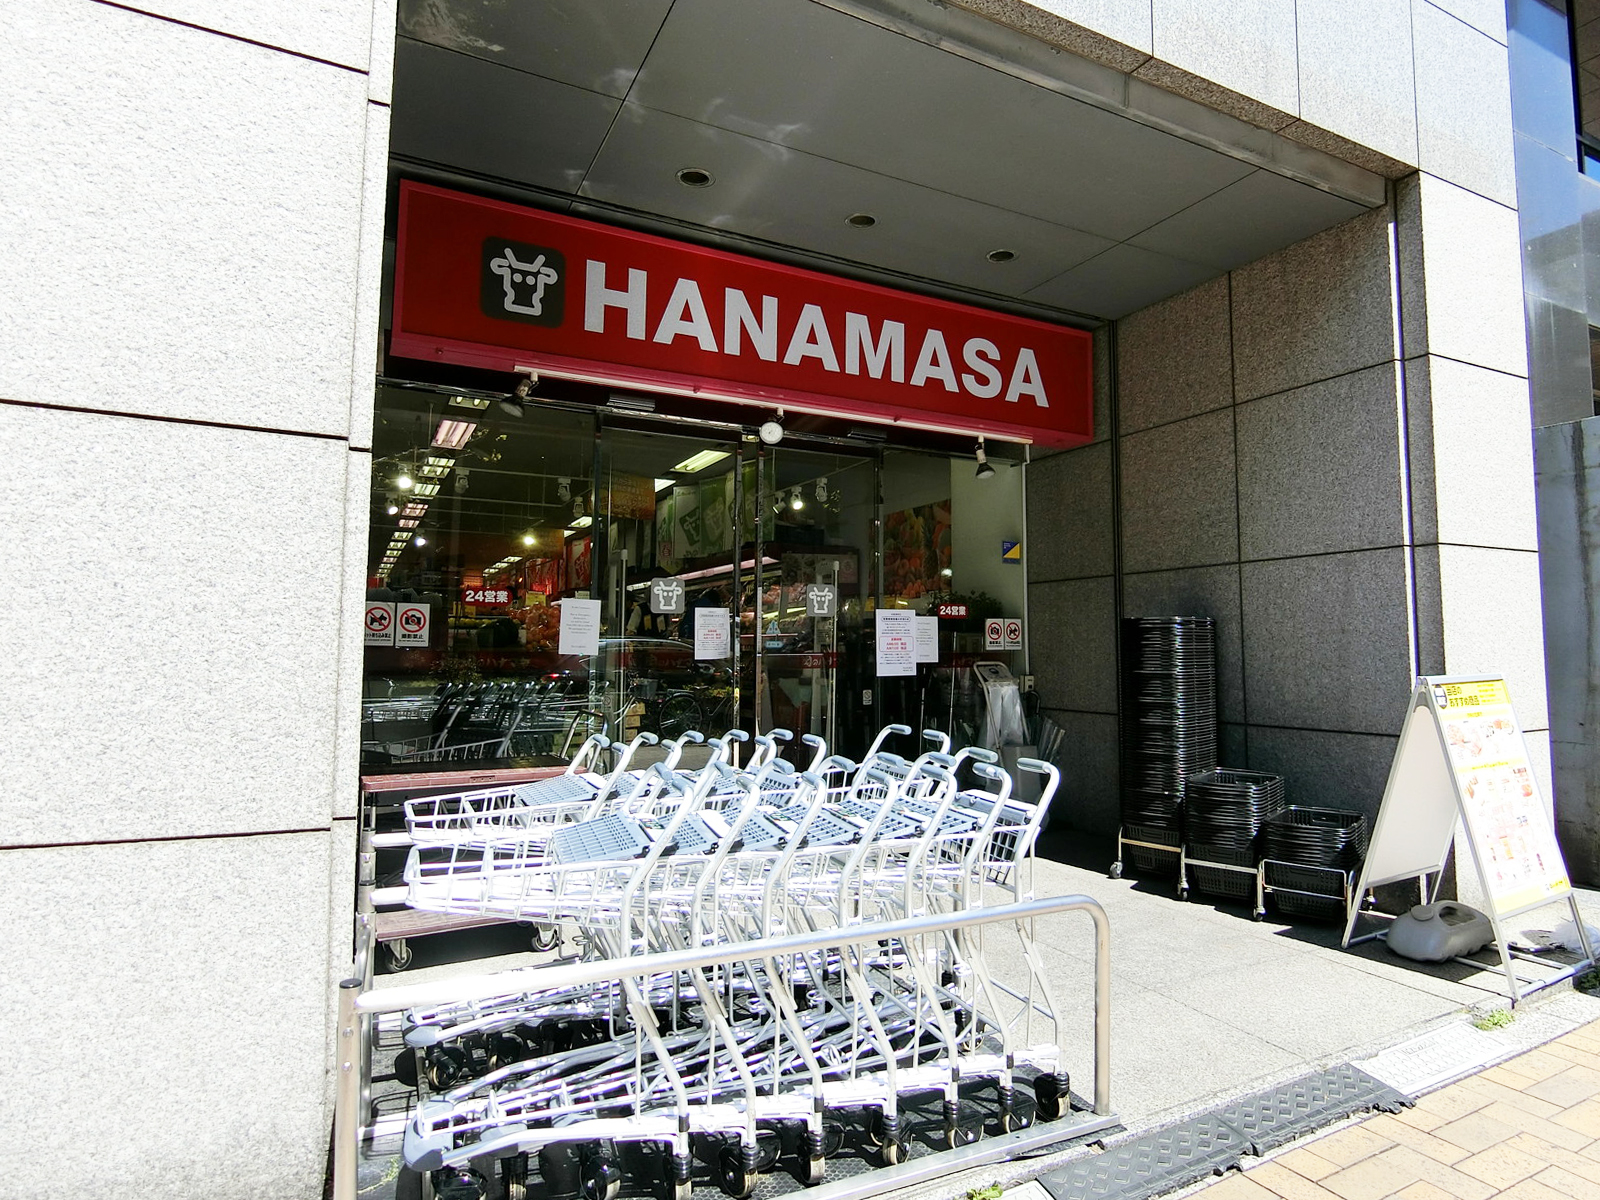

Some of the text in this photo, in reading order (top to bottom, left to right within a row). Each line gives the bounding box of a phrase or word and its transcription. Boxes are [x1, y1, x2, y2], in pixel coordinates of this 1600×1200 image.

[583, 259, 1050, 408] HANAMASA
[465, 590, 509, 603] 24営業
[940, 605, 966, 616] 24営業
